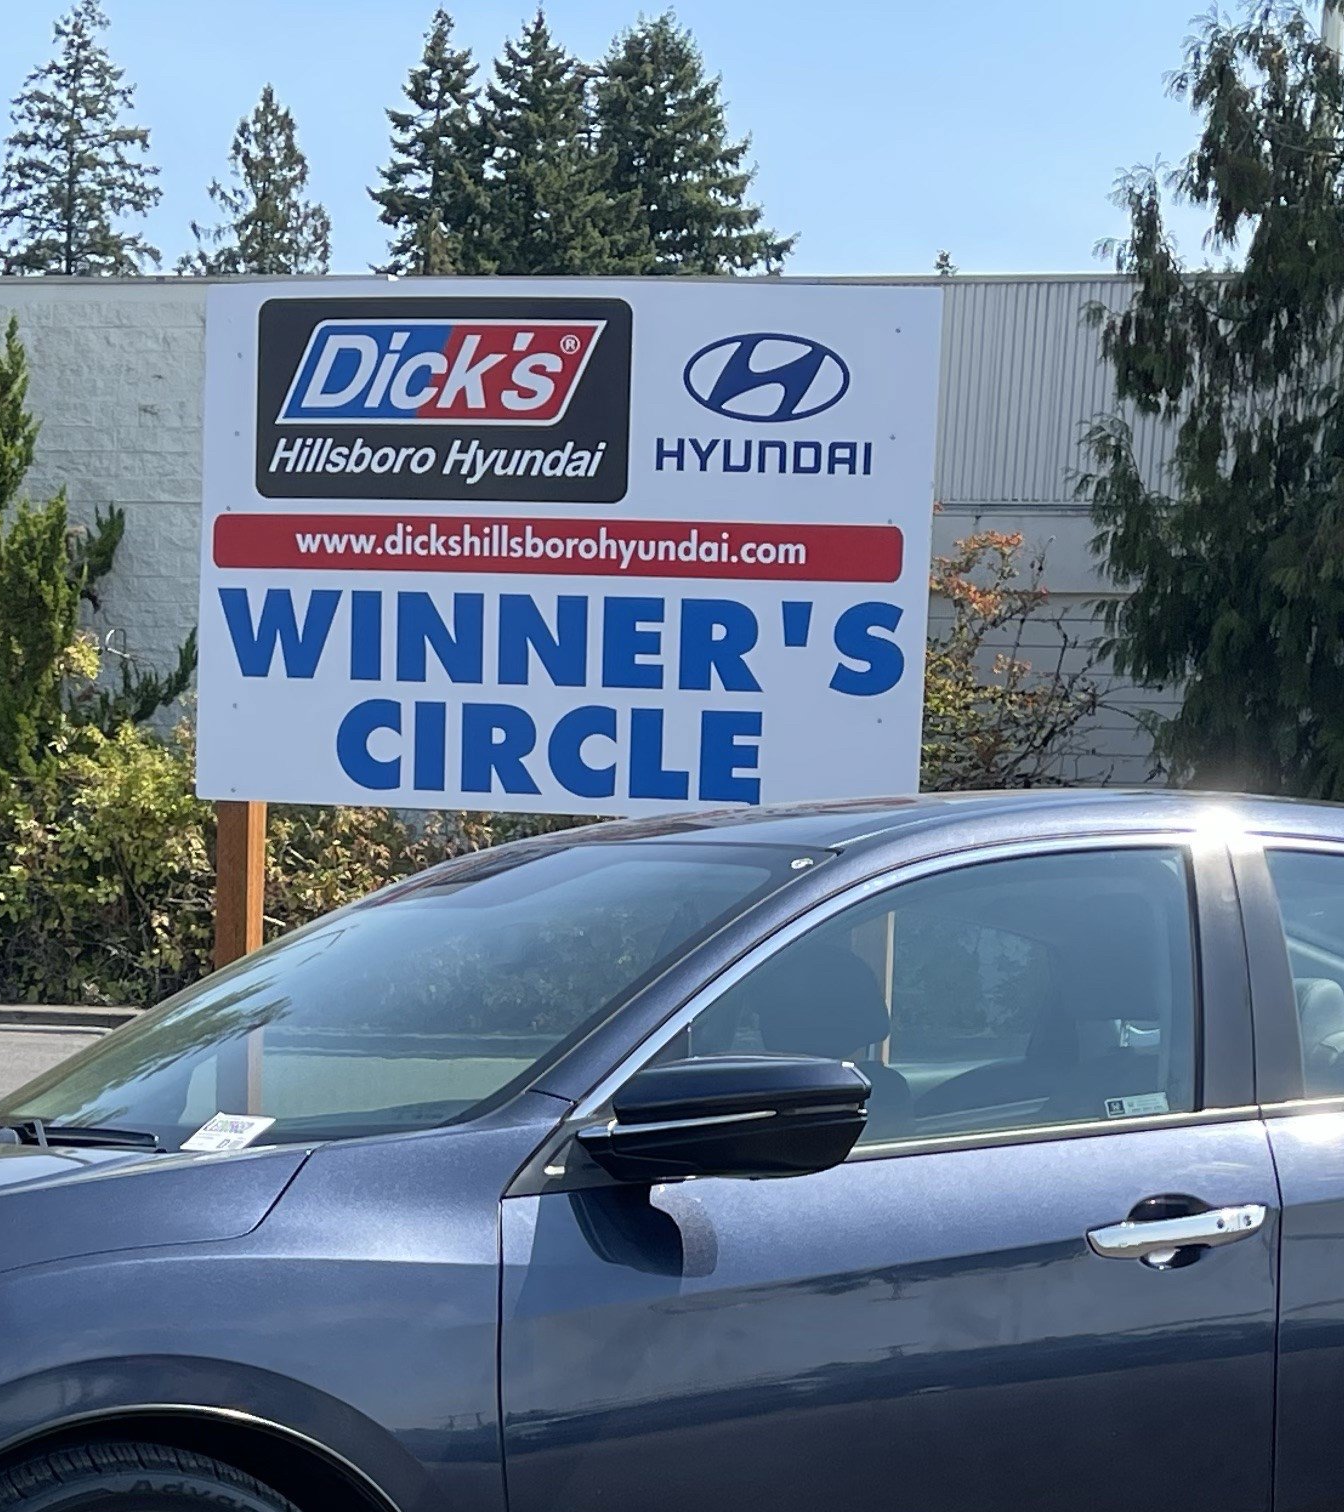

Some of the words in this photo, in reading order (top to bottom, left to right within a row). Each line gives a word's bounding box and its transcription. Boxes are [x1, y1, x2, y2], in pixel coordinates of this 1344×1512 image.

[301, 332, 563, 411] Dick's
[268, 437, 436, 474] Hillsboro
[442, 439, 605, 485] Hyundai
[655, 437, 873, 476] HYUNDAI
[295, 522, 806, 570] www.dickshillsborohyundai.com
[217, 587, 905, 697] WINNER'S
[336, 698, 763, 806] CIRCLE
